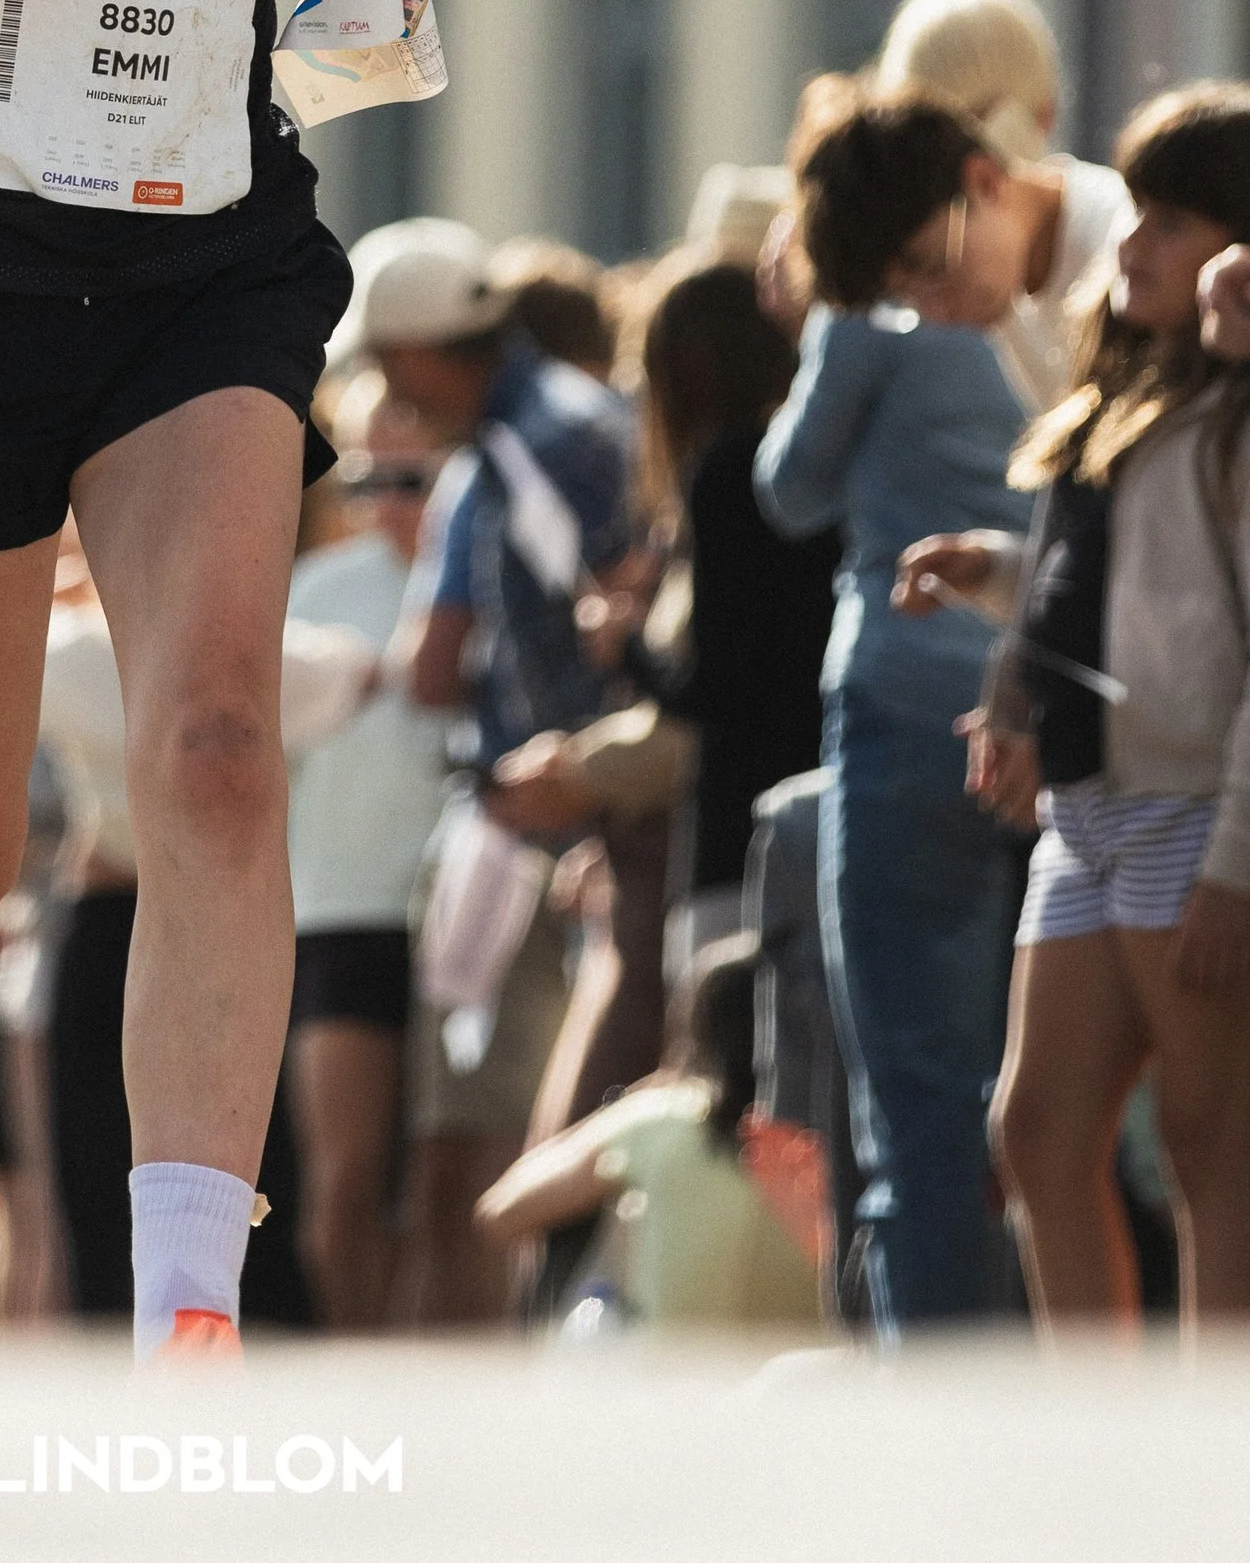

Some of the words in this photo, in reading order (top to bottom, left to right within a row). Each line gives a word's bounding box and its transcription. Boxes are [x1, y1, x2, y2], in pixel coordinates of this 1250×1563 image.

[99, 3, 175, 36] 8830
[91, 47, 170, 81] EMMI
[86, 89, 168, 107] HIIDENKIERTÄJÄT
[107, 112, 127, 125] D21
[128, 115, 147, 126] ELIT
[42, 171, 120, 192] CHALMERS
